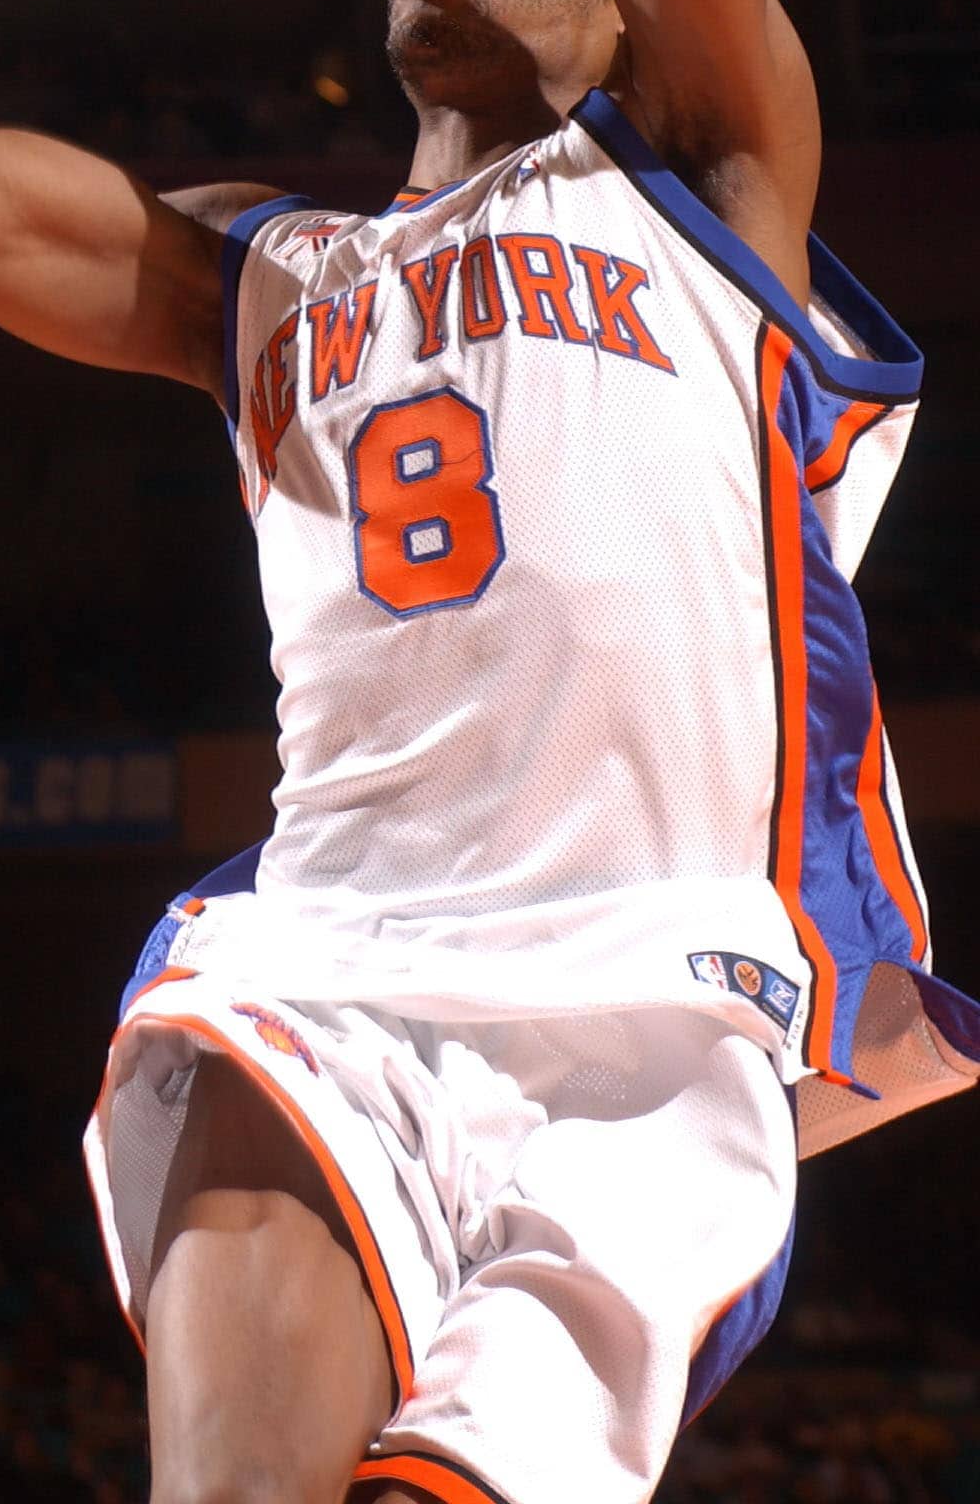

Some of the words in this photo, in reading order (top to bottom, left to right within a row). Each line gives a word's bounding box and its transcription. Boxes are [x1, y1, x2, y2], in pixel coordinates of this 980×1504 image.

[239, 280, 379, 518] NEW
[400, 232, 679, 378] YORK
[348, 384, 506, 620] 8
